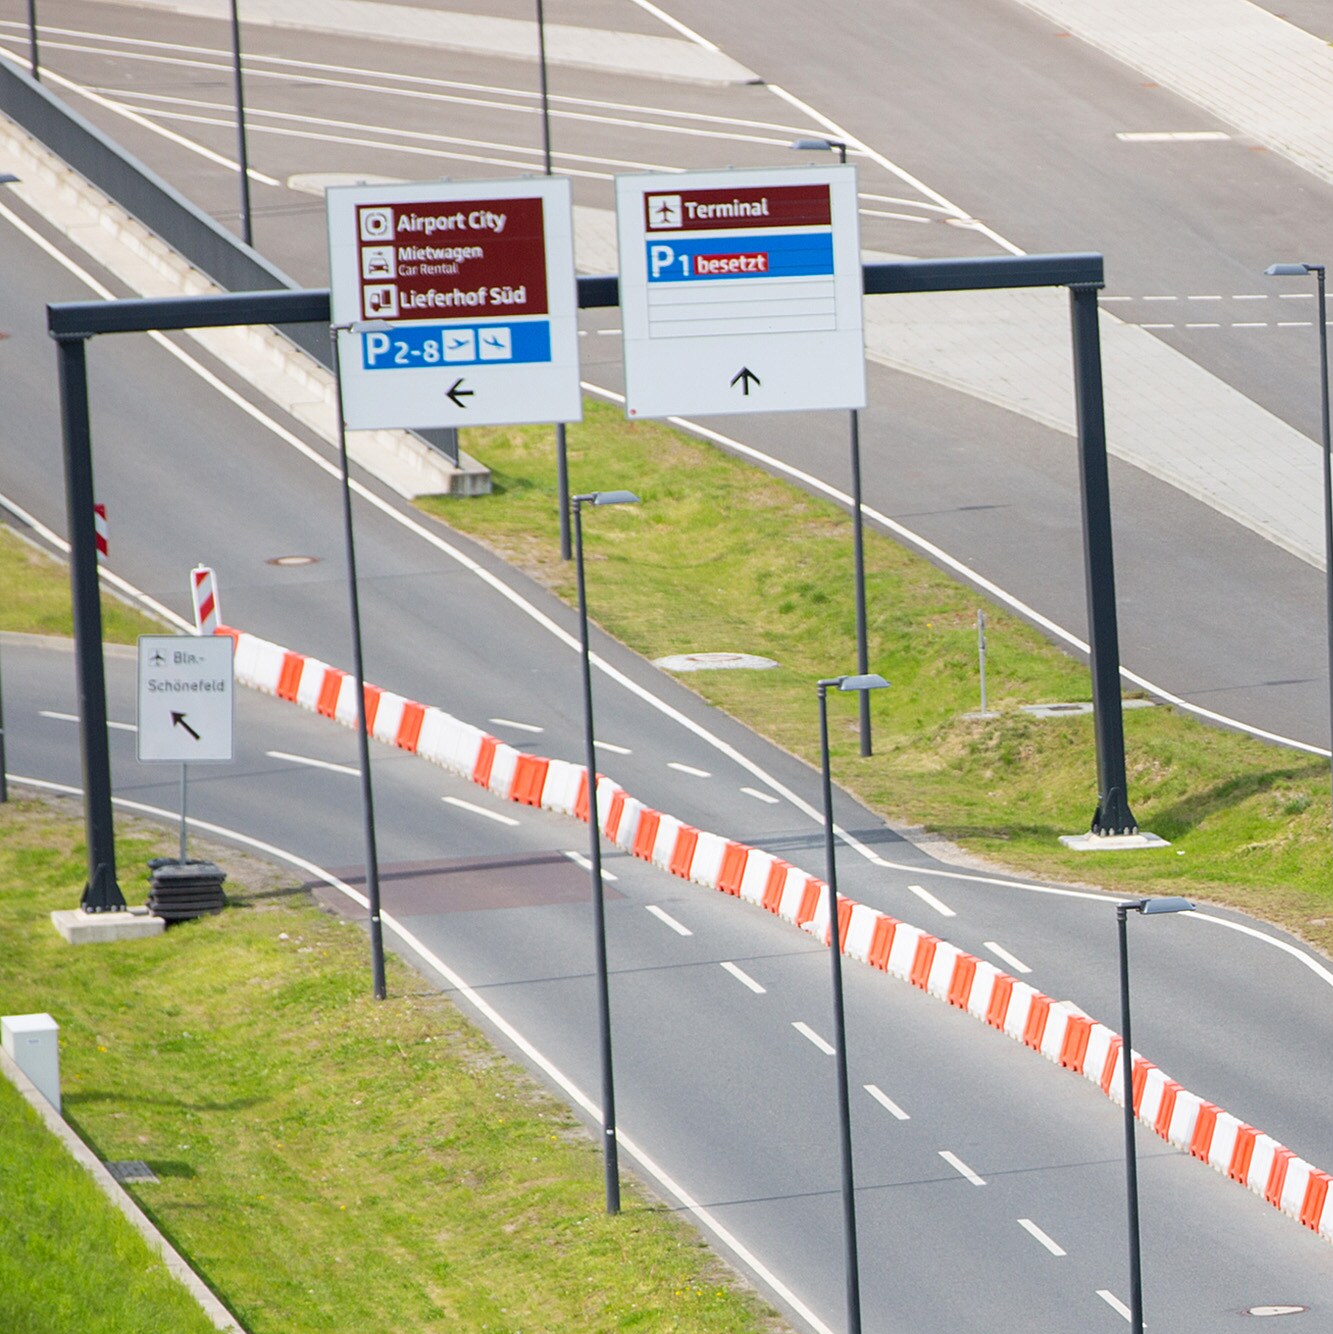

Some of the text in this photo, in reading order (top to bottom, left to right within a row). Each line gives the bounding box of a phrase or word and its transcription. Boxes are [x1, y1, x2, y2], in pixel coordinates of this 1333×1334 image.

[685, 197, 769, 220] Terminal
[397, 209, 507, 235] Airport City
[398, 244, 484, 264] Mietwagen
[650, 245, 766, 278] P 1 besetzt
[398, 261, 459, 276] Car Rental
[400, 284, 527, 309] Lieferhof Süd
[366, 332, 441, 366] P 2-8
[148, 679, 225, 692] Schönefeld
